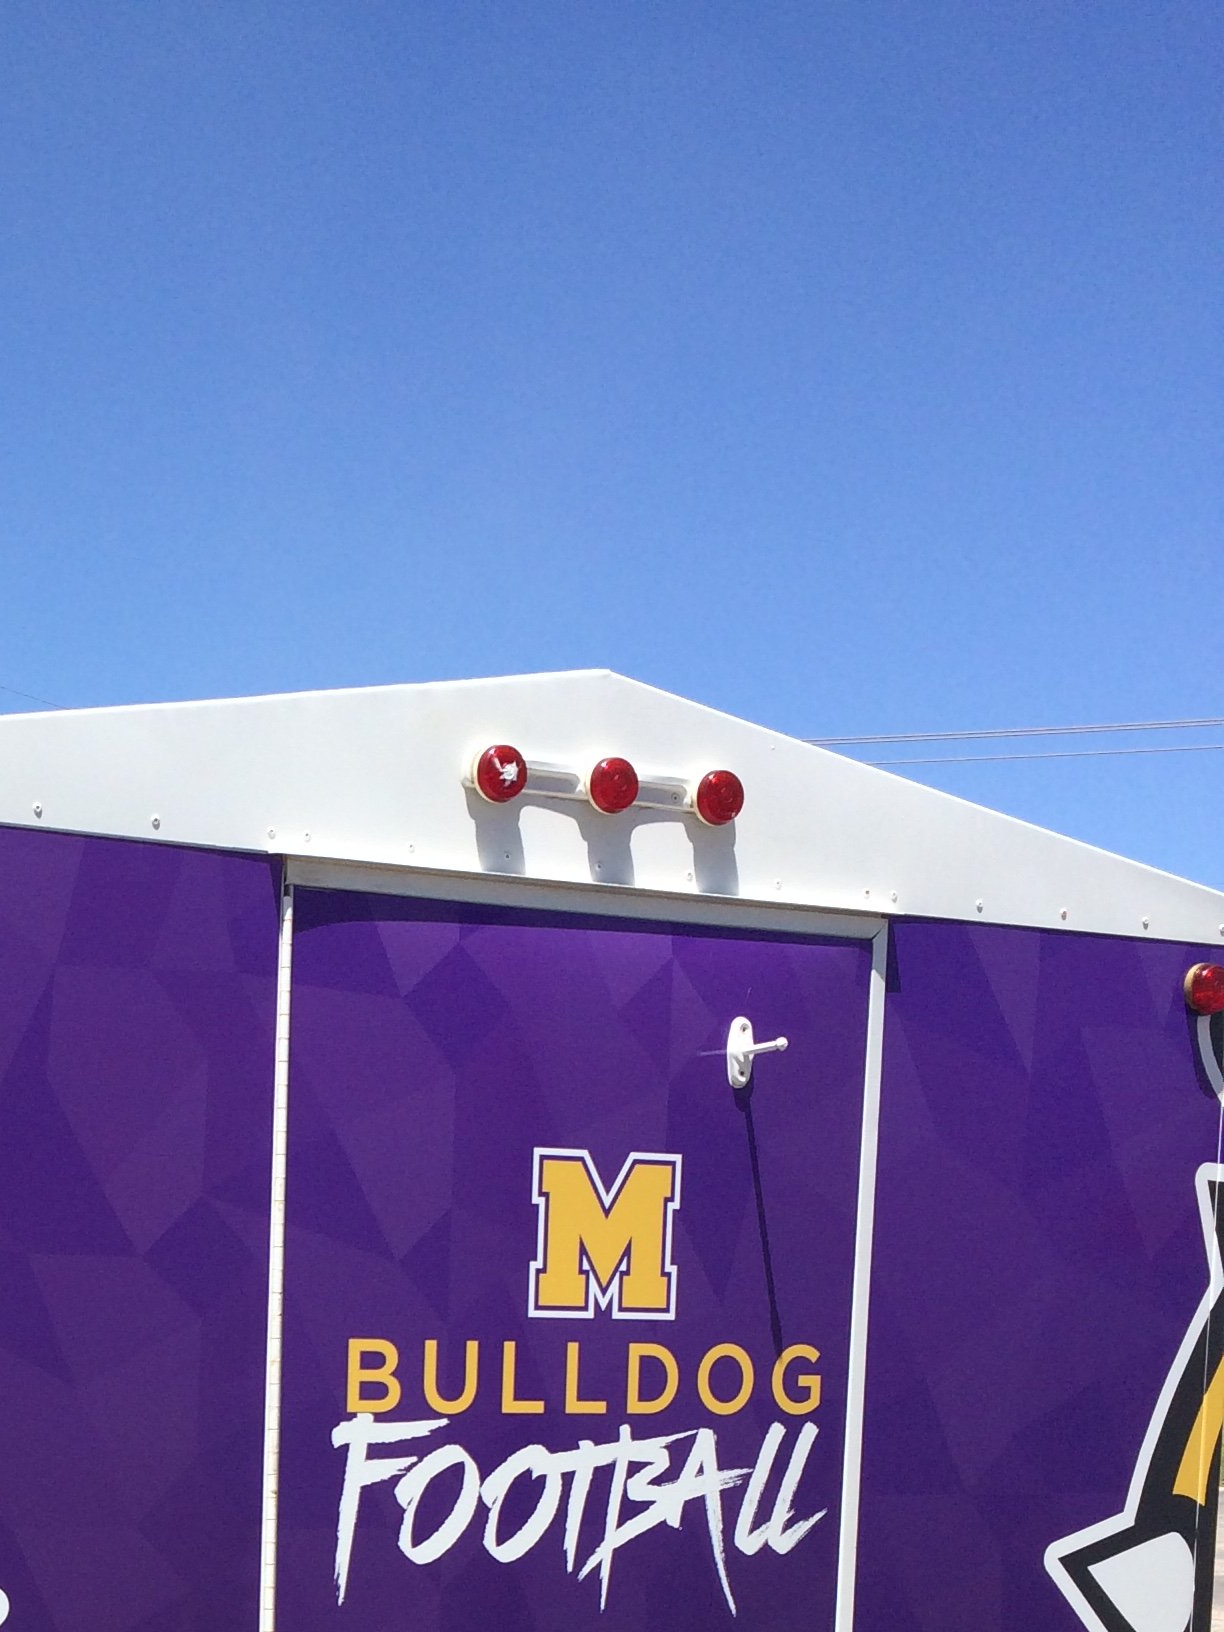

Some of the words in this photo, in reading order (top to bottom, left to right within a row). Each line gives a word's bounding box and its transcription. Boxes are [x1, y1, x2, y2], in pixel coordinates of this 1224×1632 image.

[528, 1147, 682, 1320] M
[345, 1338, 822, 1415] BULLDOG
[331, 1413, 828, 1618] FOOTBALL
